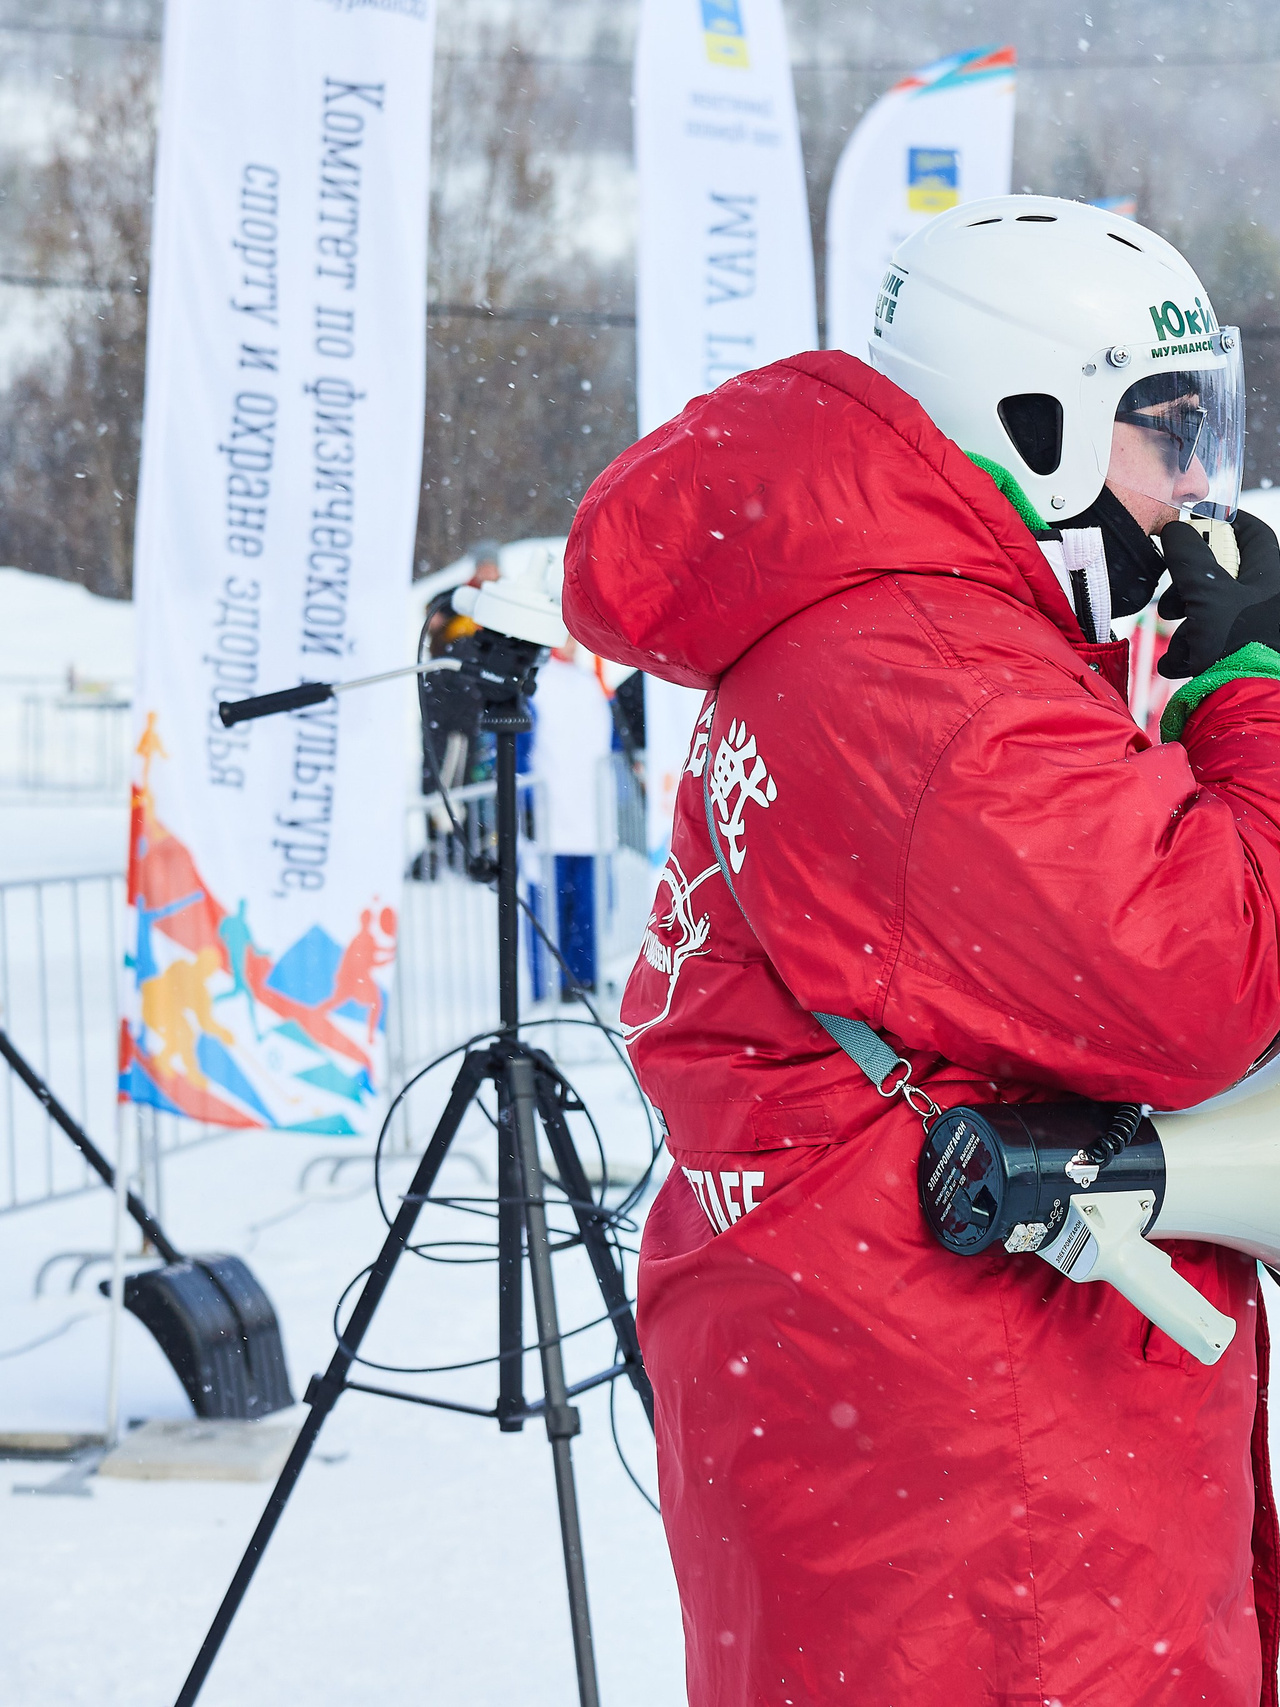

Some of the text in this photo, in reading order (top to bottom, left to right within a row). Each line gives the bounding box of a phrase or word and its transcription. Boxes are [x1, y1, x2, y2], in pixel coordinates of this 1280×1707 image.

[317, 77, 385, 290] Комитет
[231, 164, 279, 327] спорту
[239, 343, 279, 371] и
[315, 306, 355, 359] по
[218, 391, 278, 558] охране
[301, 377, 366, 656] физической
[927, 1120, 967, 1191] ЭЛЕКТРОМЕГАФОН
[1055, 1219, 1083, 1264] ЭЛЕКТРОМЕГАФОН
